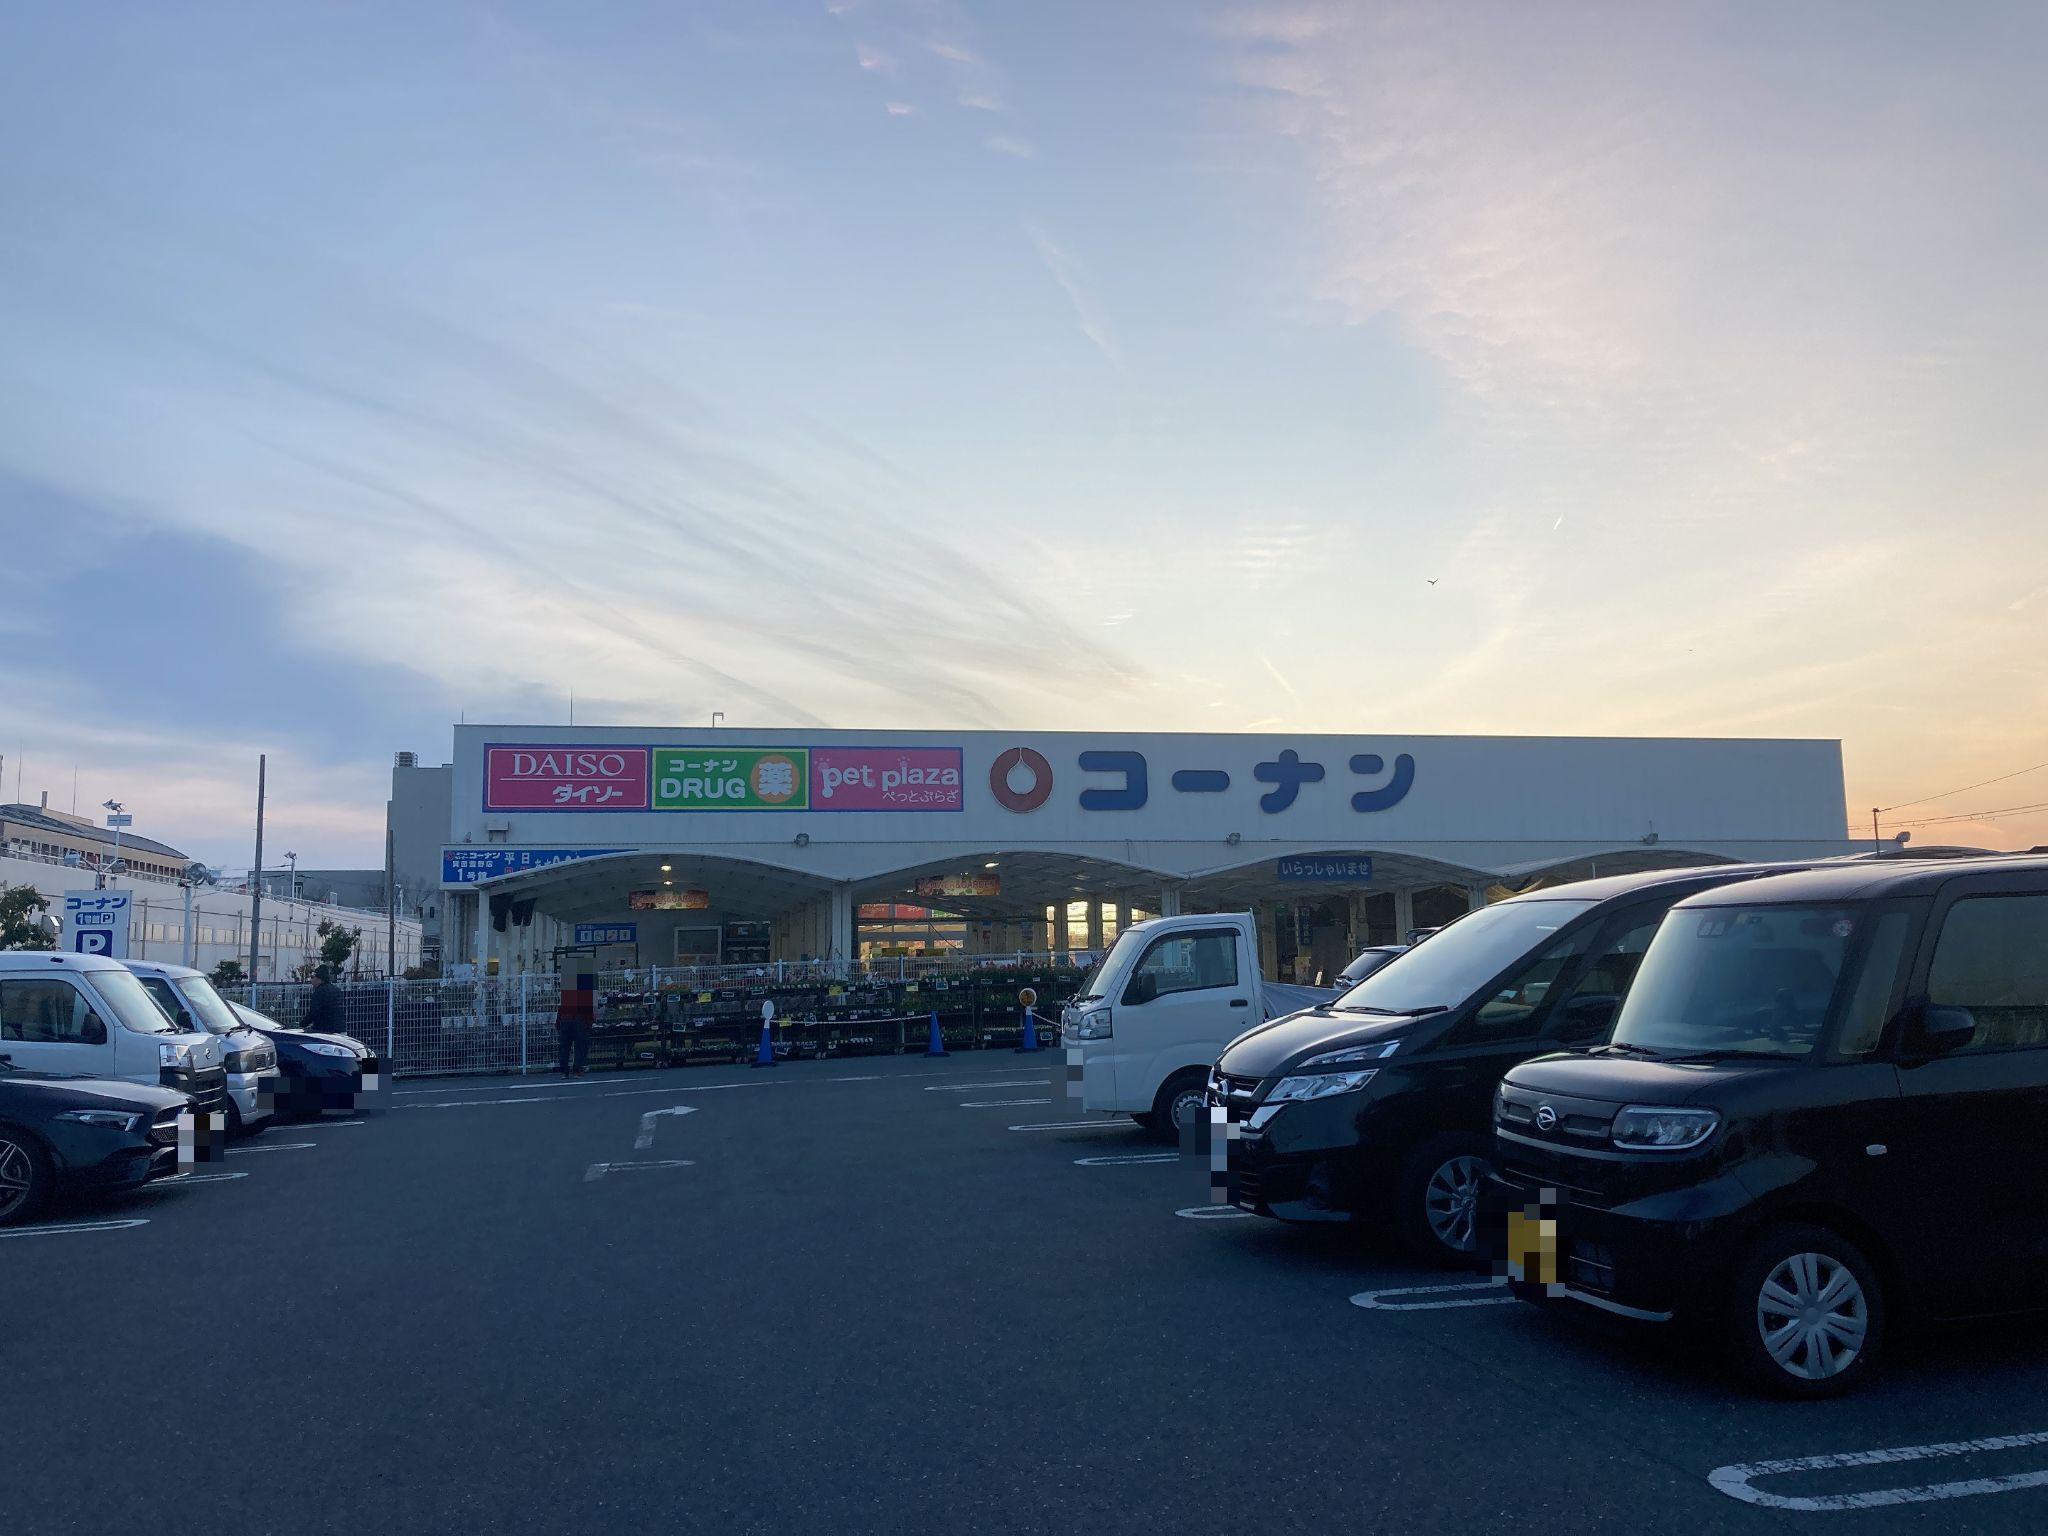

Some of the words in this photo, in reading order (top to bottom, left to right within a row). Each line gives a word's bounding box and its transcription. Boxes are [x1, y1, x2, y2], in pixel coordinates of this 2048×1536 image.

[512, 753, 625, 776] DAISO
[669, 759, 737, 773] コーナン
[660, 777, 746, 799] DRUG
[758, 762, 793, 796] 薬
[820, 764, 877, 798] pet
[881, 760, 959, 791] plaza
[1079, 748, 1415, 814] コーナン
[552, 783, 623, 803] ダイソー
[1282, 861, 1370, 877] いらっしゃいませ
[67, 898, 127, 909] コーナン
[82, 933, 106, 954] P
